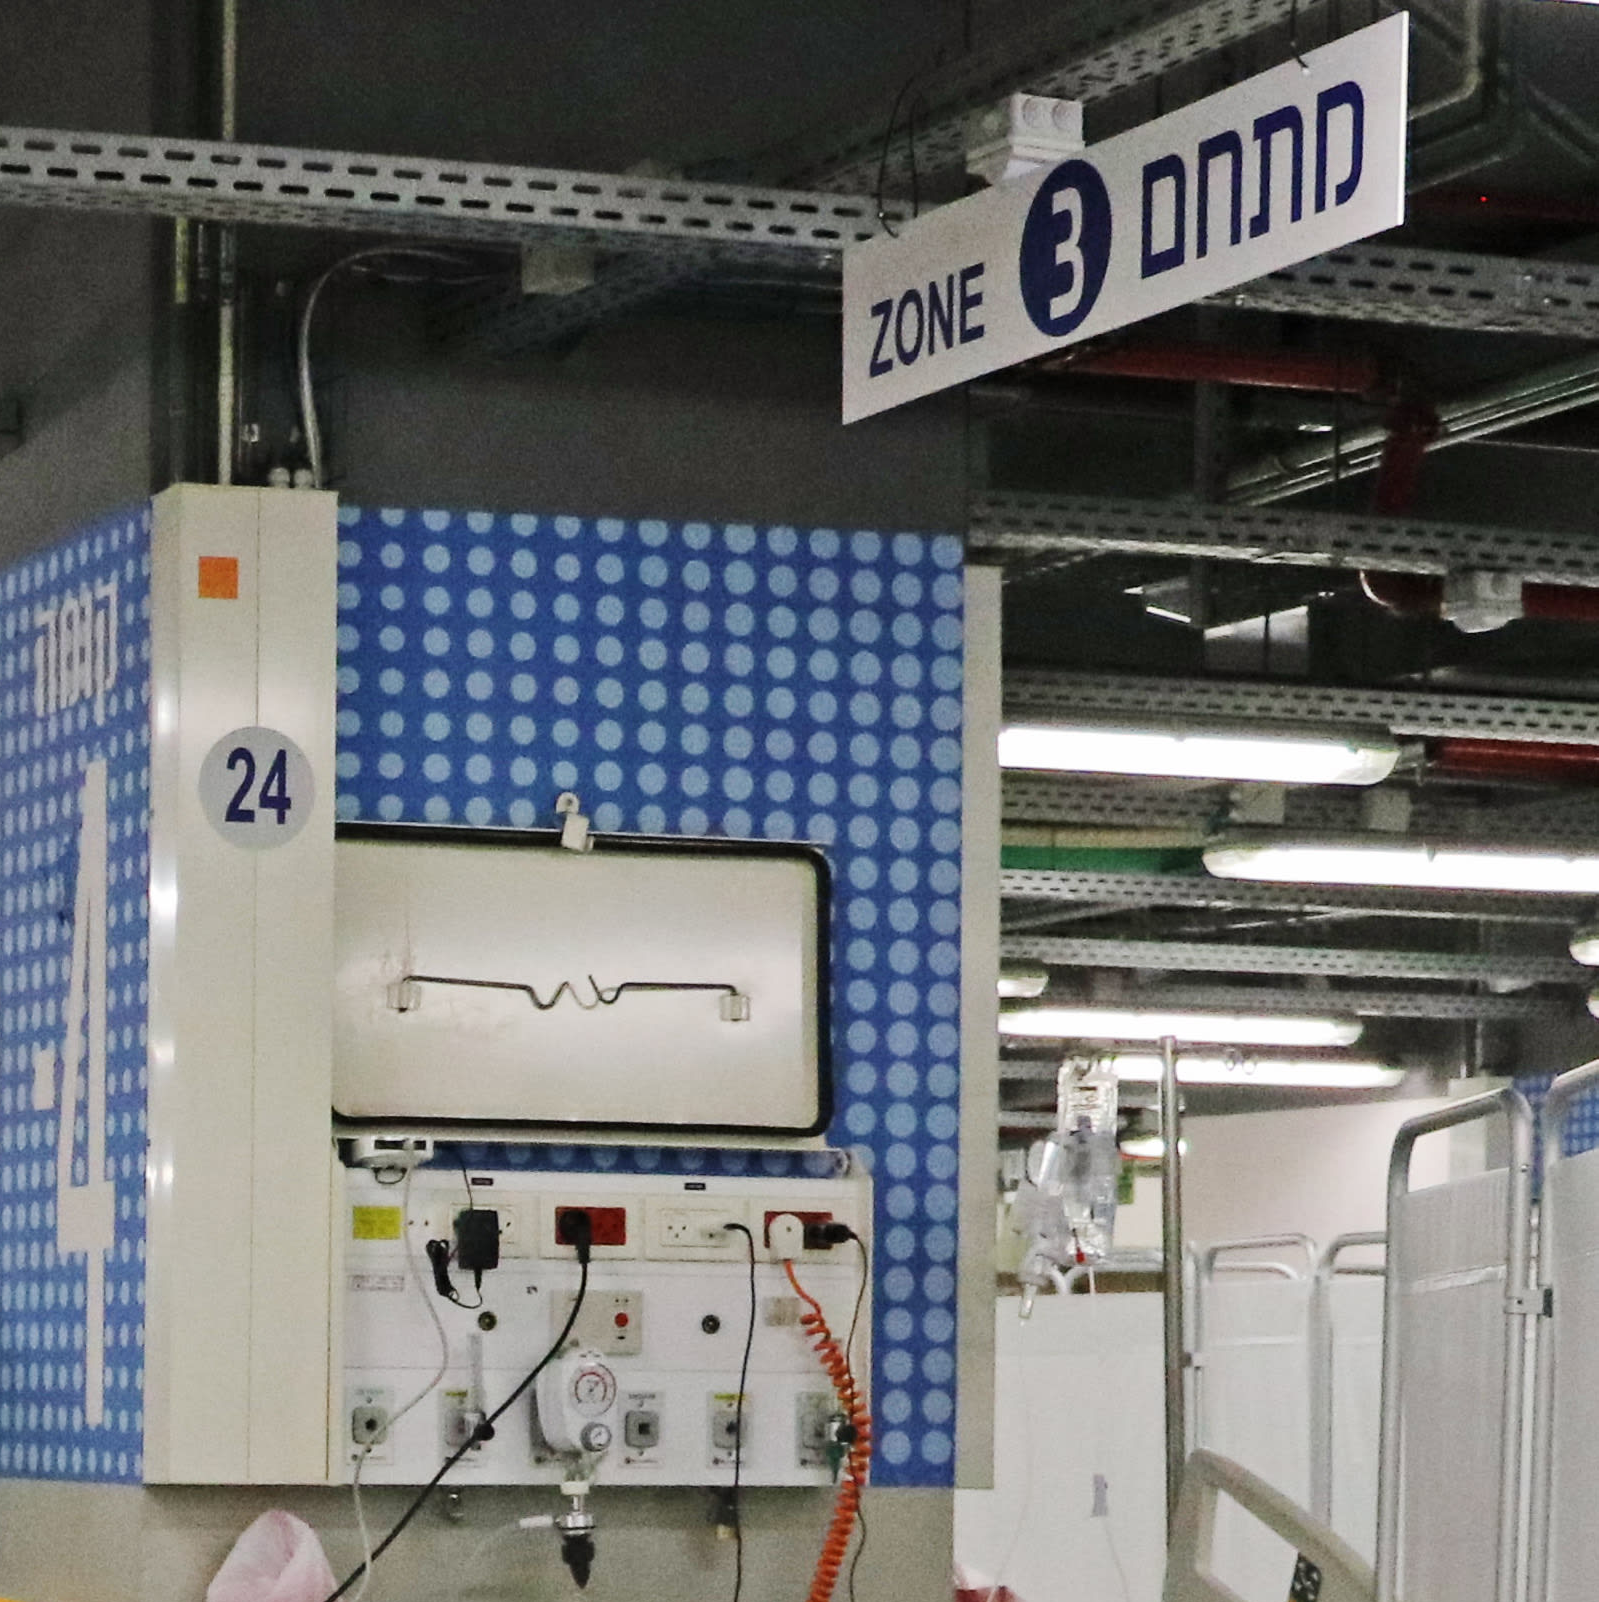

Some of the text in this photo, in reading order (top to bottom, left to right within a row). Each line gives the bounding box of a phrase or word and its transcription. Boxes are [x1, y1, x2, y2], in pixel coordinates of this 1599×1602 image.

[869, 81, 1364, 378] ZONE 3 מתחם
[33, 578, 119, 727] קומה
[225, 746, 292, 825] 24
